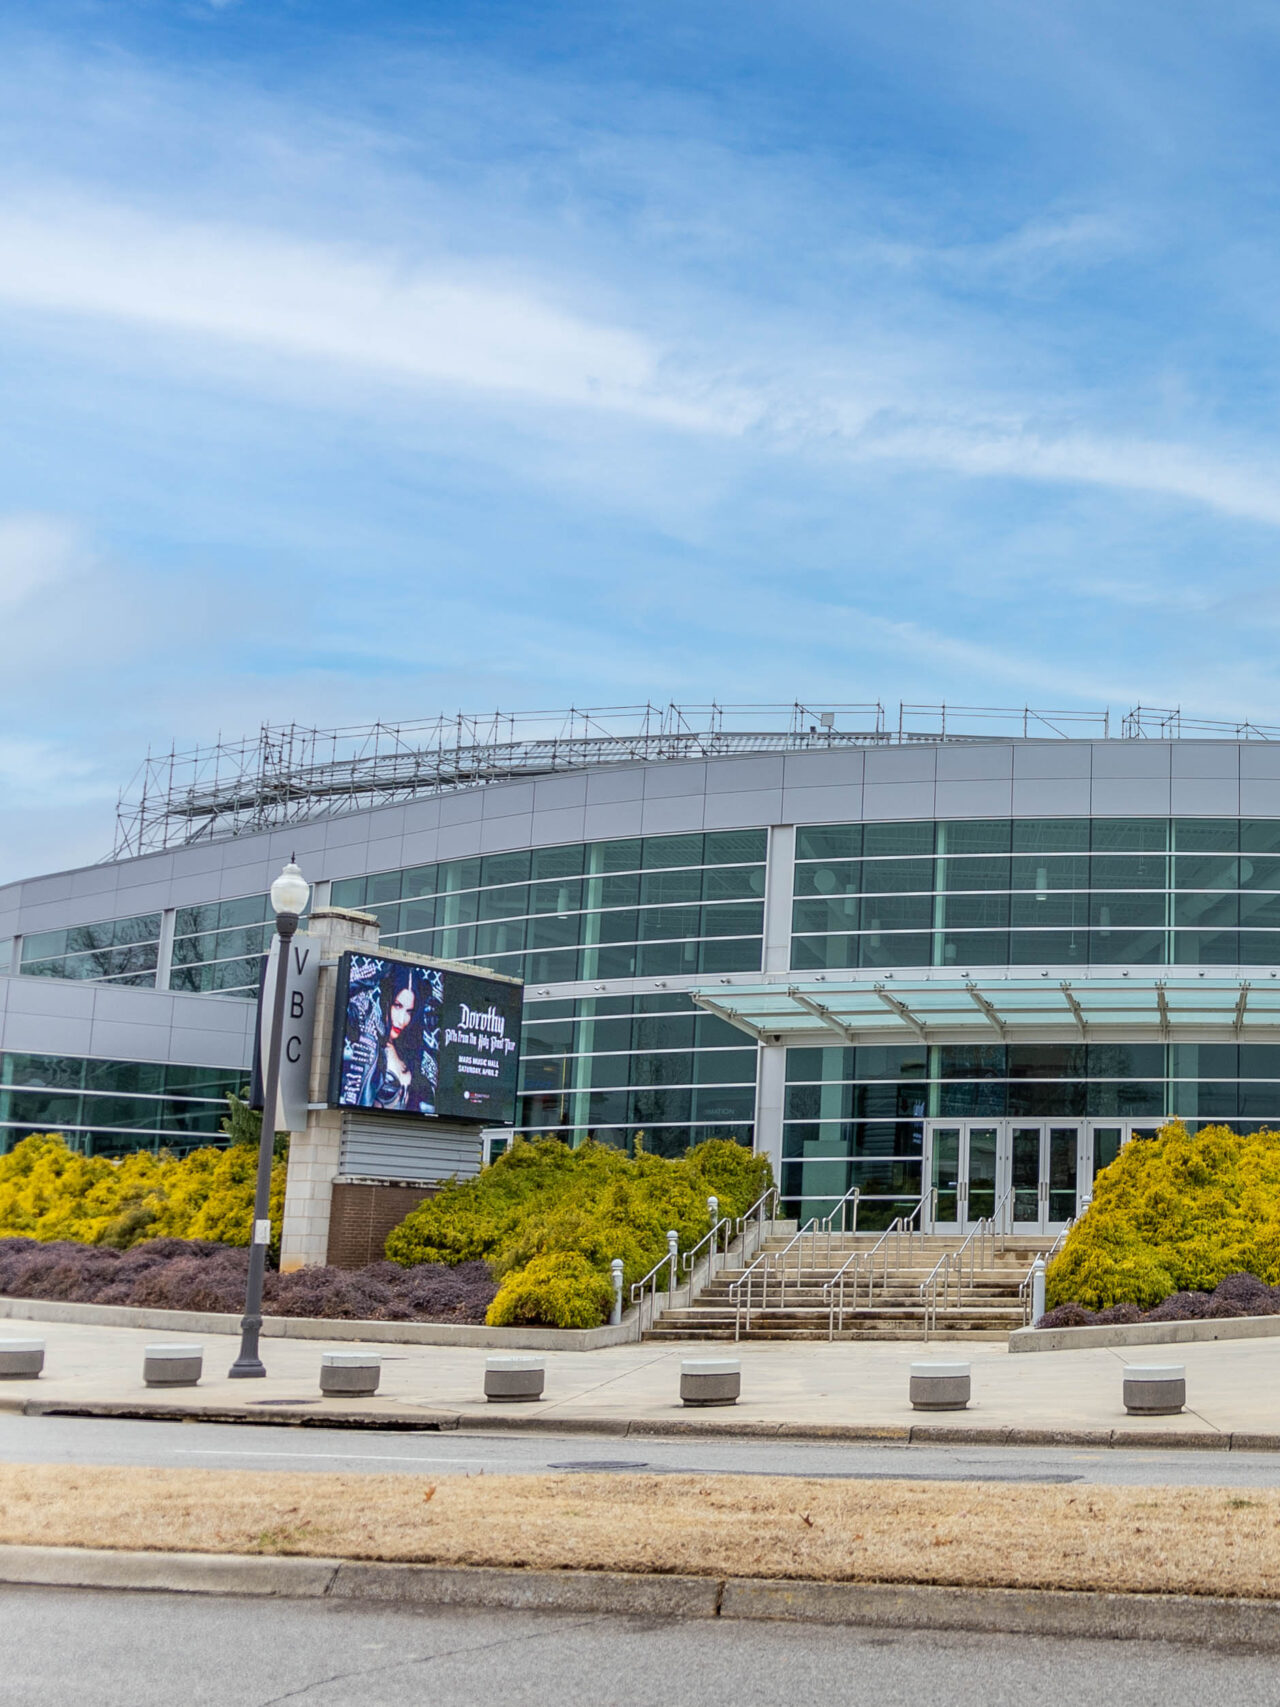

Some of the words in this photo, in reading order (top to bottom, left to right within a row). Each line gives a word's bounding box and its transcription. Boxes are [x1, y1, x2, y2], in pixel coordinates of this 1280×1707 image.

[457, 1003, 505, 1038] Dorothy
[473, 1057, 488, 1066] MUSIC
[488, 1060, 499, 1068] HALL
[482, 1068, 495, 1077] APRIL
